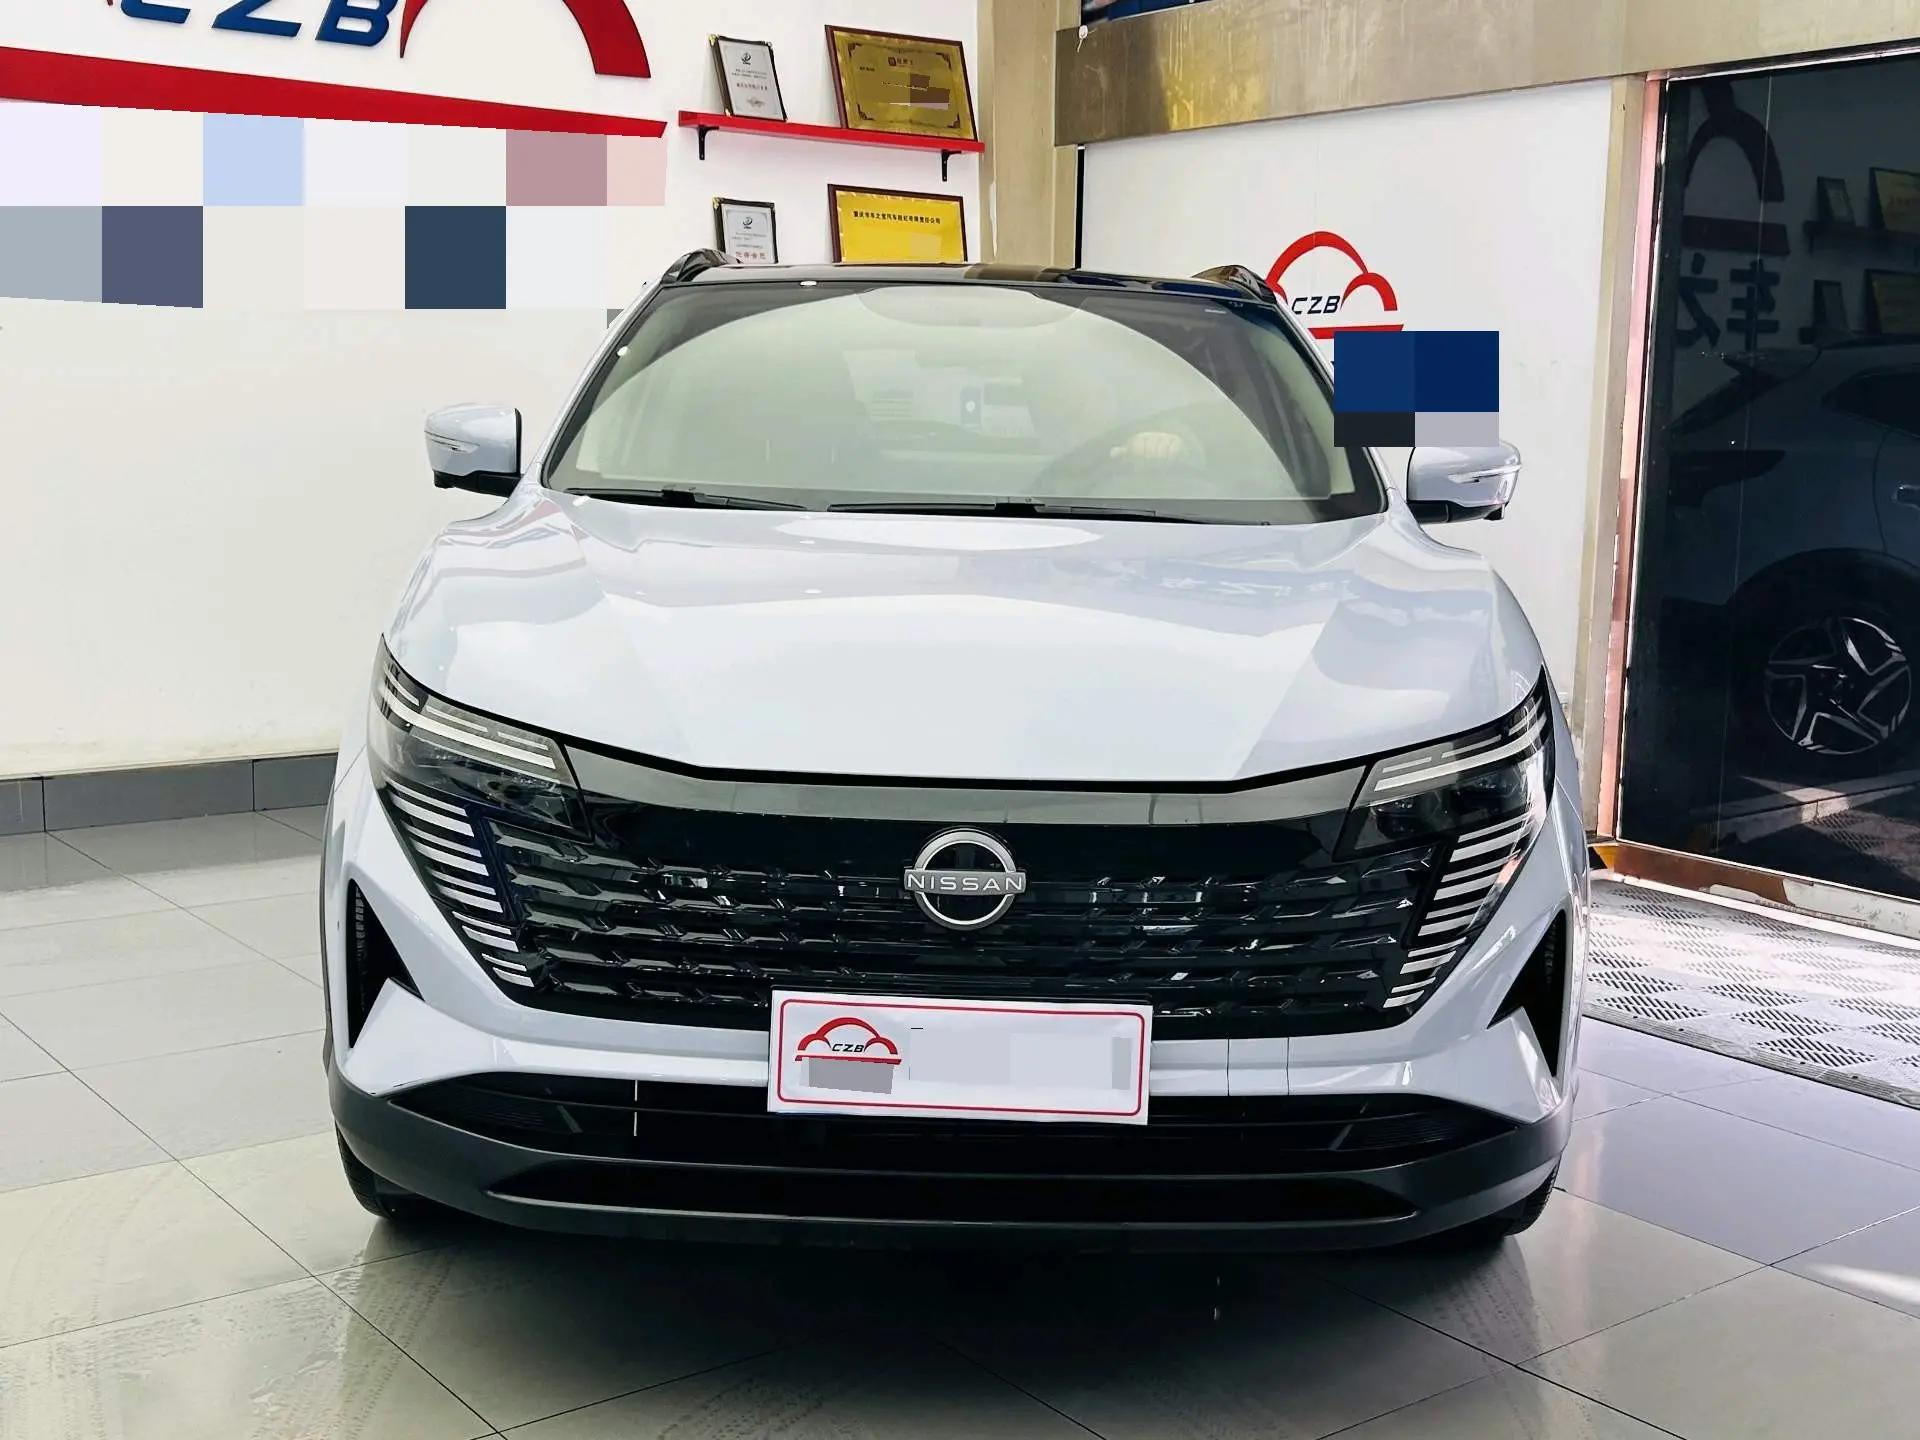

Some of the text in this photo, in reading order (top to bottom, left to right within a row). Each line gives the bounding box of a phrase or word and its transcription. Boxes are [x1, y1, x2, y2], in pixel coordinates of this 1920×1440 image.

[1290, 295, 1341, 315] CZB
[907, 873, 1023, 892] NISSAN
[831, 1042, 865, 1054] CZB
